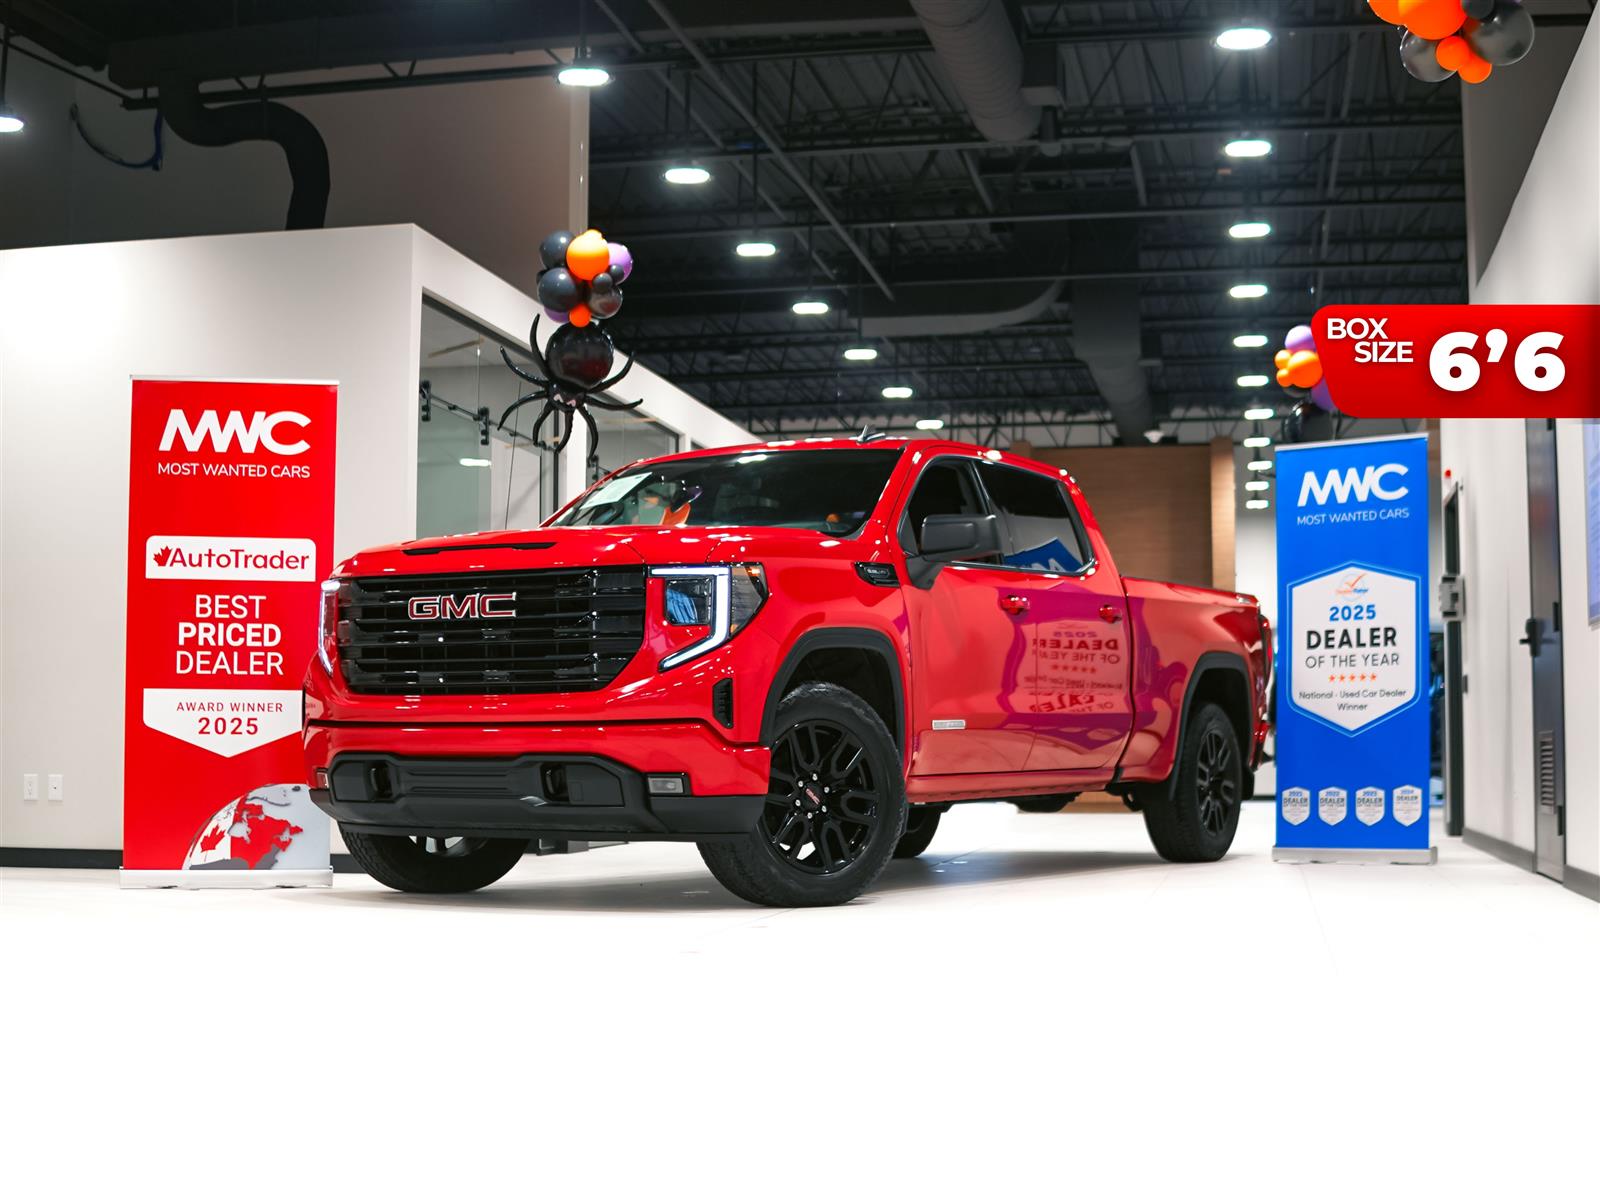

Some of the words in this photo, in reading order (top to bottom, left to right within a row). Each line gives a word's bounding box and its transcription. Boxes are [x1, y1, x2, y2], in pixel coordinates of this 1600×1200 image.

[158, 408, 312, 456] MWC
[157, 462, 200, 476] MOST
[202, 463, 268, 478] WANTED
[270, 465, 311, 479] CARS
[1297, 463, 1409, 507] MWC
[1297, 513, 1327, 526] MOST
[1329, 510, 1378, 523] WANTED
[1379, 507, 1410, 520] CARS
[169, 547, 310, 570] AutoTrader
[195, 594, 267, 620] BEST
[408, 591, 517, 621] GMC
[1329, 604, 1377, 622] 2025
[178, 622, 282, 647] PRICED
[1306, 627, 1397, 650] DEALER
[176, 650, 284, 676] DEALER
[1305, 655, 1325, 669] OF
[1330, 654, 1357, 668] THE
[1361, 653, 1400, 667] YEAR
[1298, 690, 1334, 700] National
[1339, 689, 1360, 699] Used
[1362, 689, 1378, 698] Car
[1379, 688, 1407, 698] Dealer
[176, 701, 225, 713] AWARD
[230, 702, 284, 713] WINNER
[1336, 702, 1368, 711] Winner
[198, 716, 260, 735] 2025
